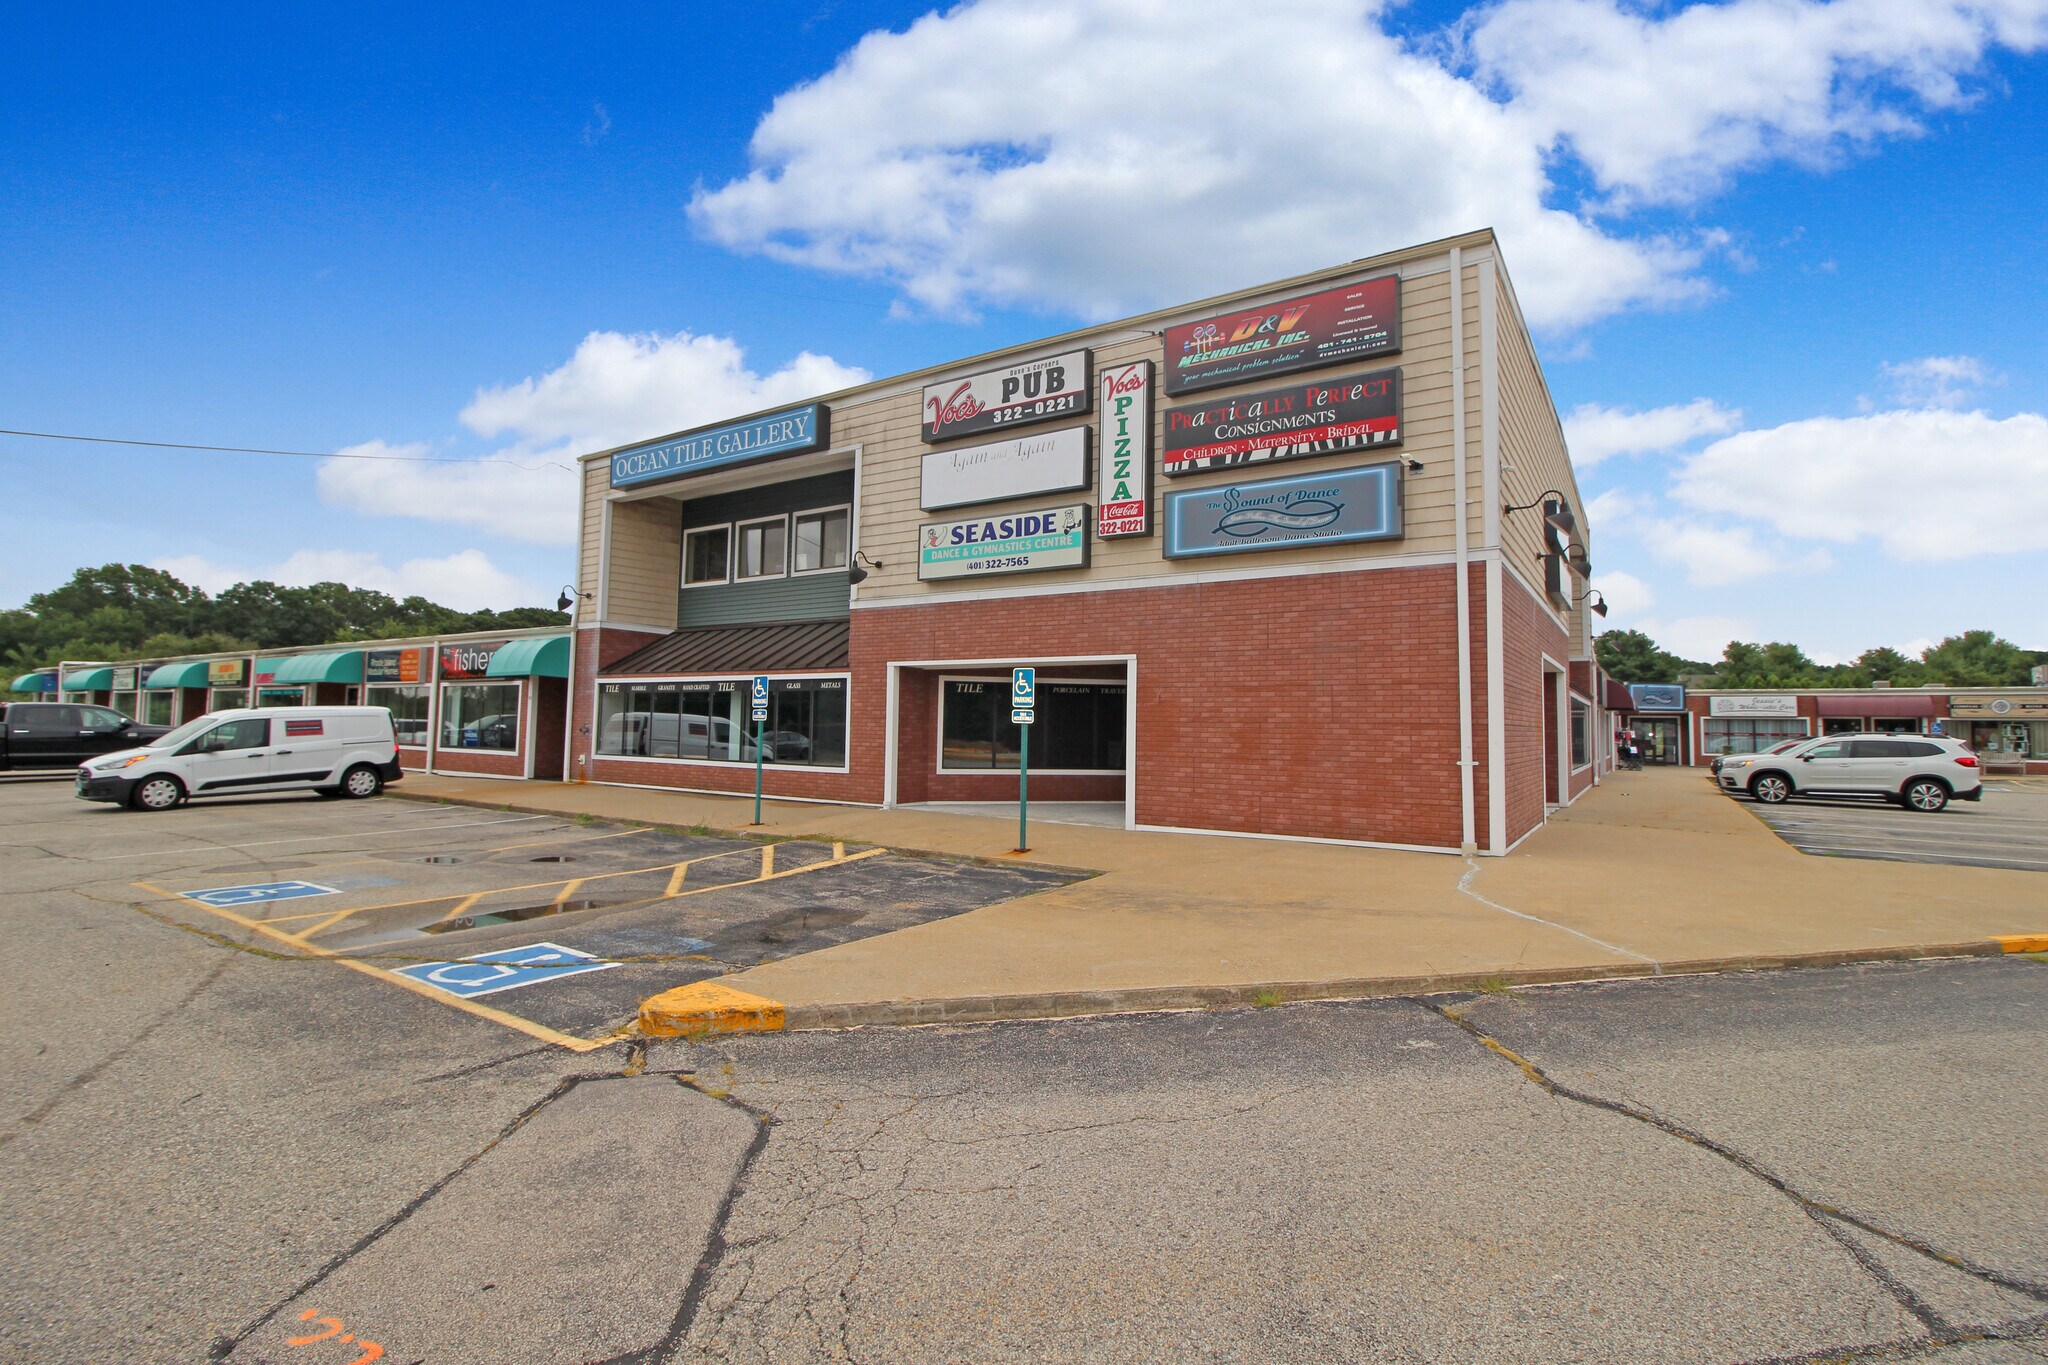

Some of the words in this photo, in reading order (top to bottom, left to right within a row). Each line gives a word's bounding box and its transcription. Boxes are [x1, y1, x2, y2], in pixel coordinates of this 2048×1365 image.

[1337, 315, 1373, 326] INSTALLATION
[1341, 337, 1357, 345] 741
[1364, 331, 1388, 340] 2704
[1177, 339, 1271, 368] MECHANICAL
[1276, 330, 1310, 348] INC.
[1319, 341, 1387, 358] dvmechanical.com
[1032, 360, 1060, 371] Corners
[1202, 363, 1240, 378] mechanical
[1241, 359, 1269, 372] problem
[1002, 366, 1065, 404] PUB
[993, 395, 1075, 424] 322-0221
[616, 449, 670, 478] OCEAN
[674, 438, 714, 465] TILE
[717, 415, 809, 455] GALLERY
[1110, 396, 1133, 501] PIZZA
[1223, 488, 1274, 512] Sound
[1277, 491, 1291, 505] of
[1294, 488, 1340, 500] Dance
[950, 513, 1058, 546] SEASIDE
[1100, 519, 1143, 535] 322-0221
[931, 545, 960, 560] DANCE
[962, 544, 969, 557] &
[972, 536, 1032, 556] GYMNASTICS
[1034, 534, 1073, 550] CENTRE
[1240, 536, 1280, 545] Ballroom
[1312, 530, 1342, 538] Studio
[966, 558, 984, 571] (401)
[985, 556, 1029, 570] 322-7565
[454, 648, 497, 671] fisher
[605, 684, 620, 692] TILE
[718, 682, 736, 692] TILE
[956, 683, 984, 693] TILE
[1052, 686, 1091, 694] PORCELAIN
